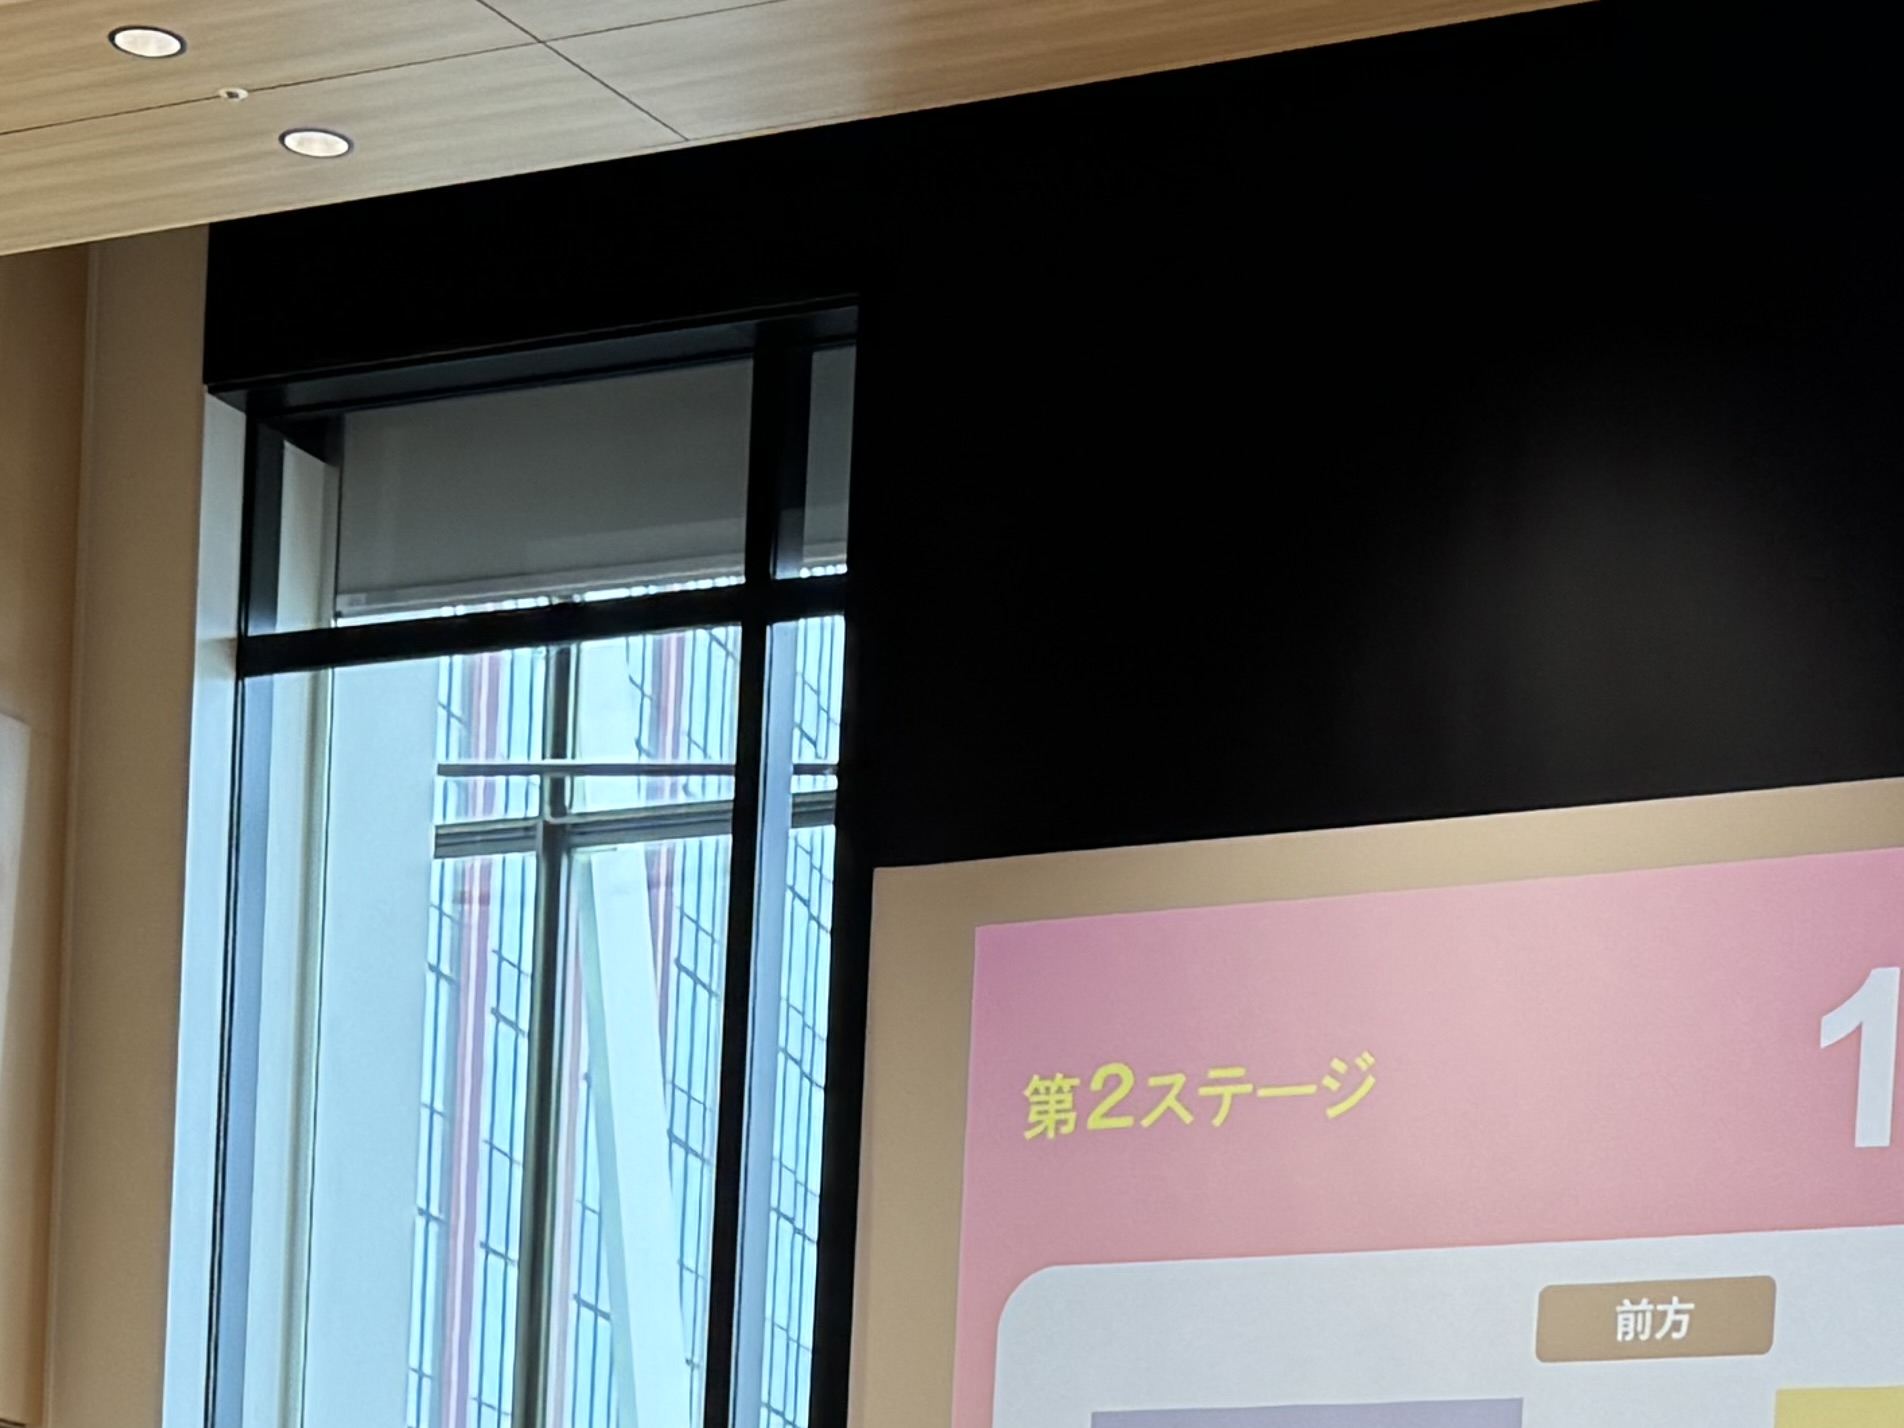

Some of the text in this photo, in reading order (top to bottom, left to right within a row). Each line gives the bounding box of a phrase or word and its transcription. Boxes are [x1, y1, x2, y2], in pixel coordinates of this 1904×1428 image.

[1022, 1051, 1378, 1141] 第2ステージ
[1615, 1296, 1696, 1343] 前方
